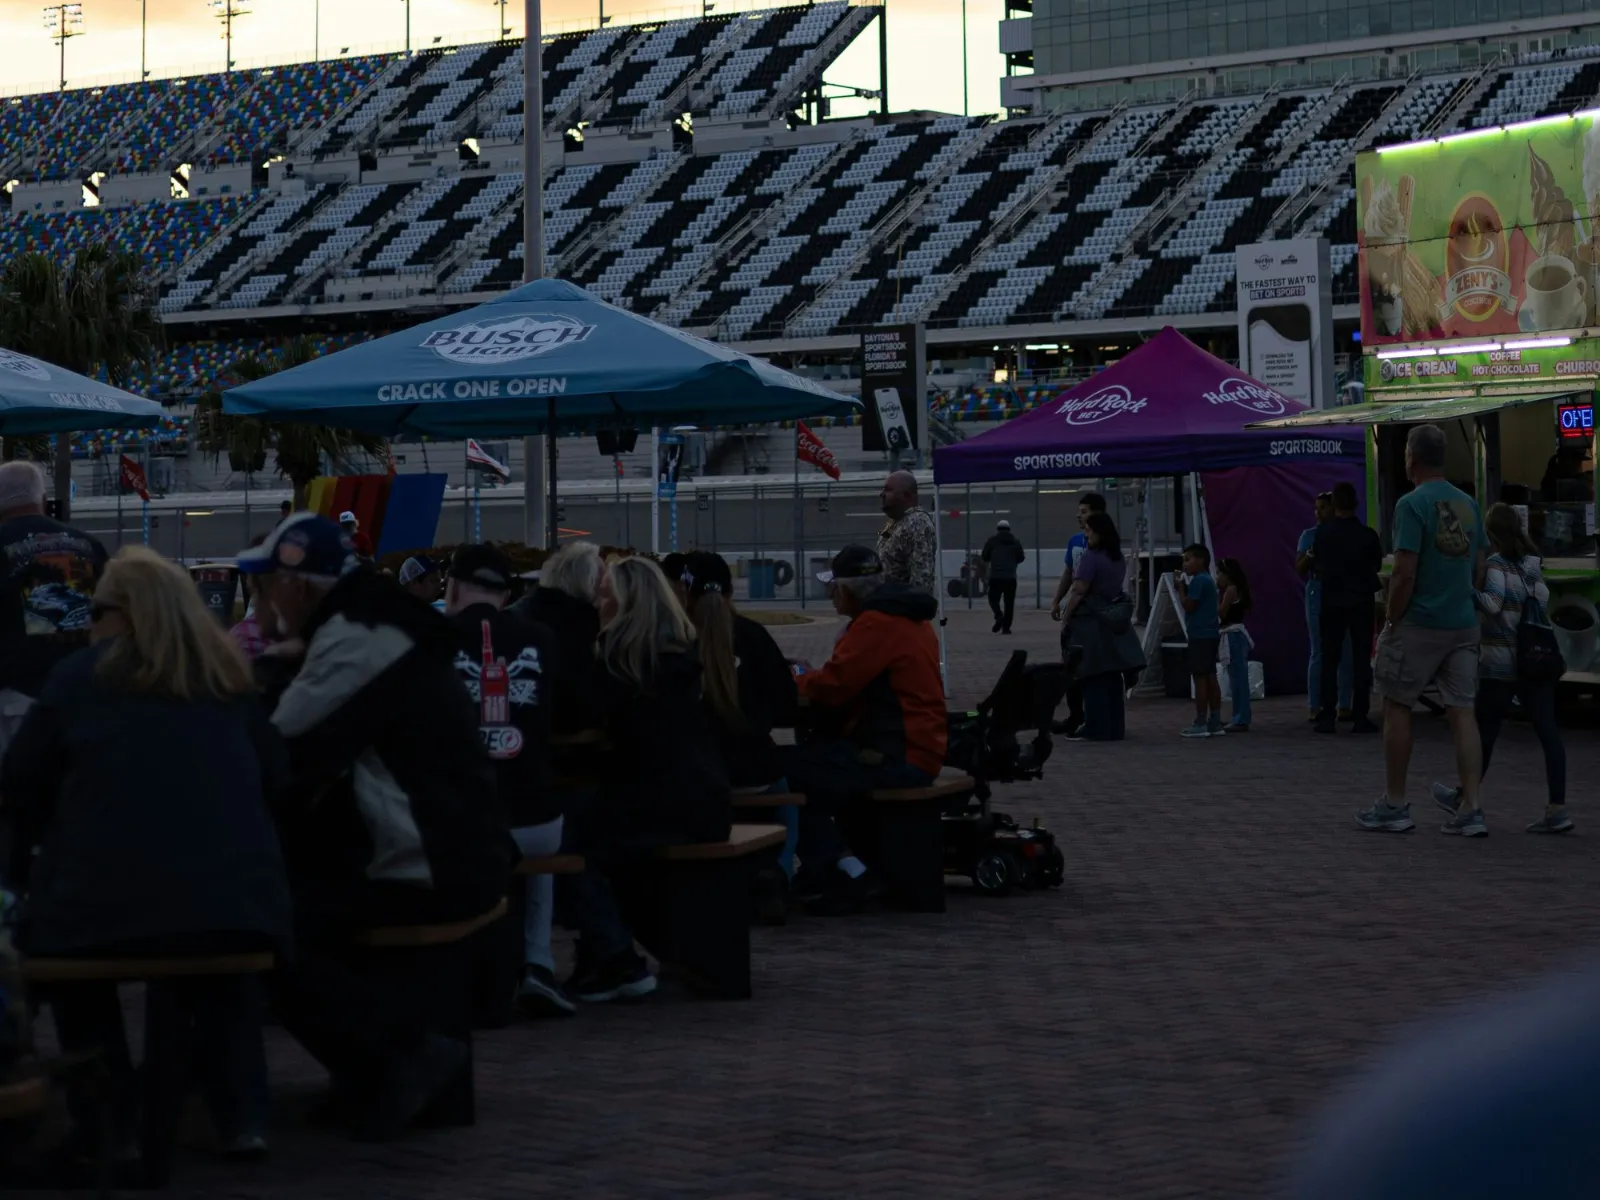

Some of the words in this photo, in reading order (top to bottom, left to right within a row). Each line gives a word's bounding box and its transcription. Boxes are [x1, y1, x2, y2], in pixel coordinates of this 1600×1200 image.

[1240, 281, 1254, 289] THE
[1255, 278, 1286, 288] FASTEST
[1288, 276, 1304, 285] WAY
[1307, 275, 1316, 283] TO
[1456, 271, 1497, 294] ZENY'S
[1251, 290, 1264, 299] BET
[1265, 289, 1275, 298] ON
[1276, 287, 1304, 297] SPORTS
[424, 326, 593, 346] BUSCH
[864, 332, 900, 342] DAYTONA'S
[449, 345, 545, 355] LIGHT
[864, 342, 908, 352] SPORTSBOOK
[864, 351, 897, 361] FLORIDA'S
[1490, 351, 1520, 362] COFFEE
[864, 360, 908, 371] SPORTSBOOK
[1393, 362, 1412, 377] ICE
[1415, 360, 1457, 376] CREAM
[1472, 366, 1490, 375] HOT
[1490, 364, 1540, 375] CHOCOLATE
[377, 382, 447, 401] CRACK
[453, 380, 500, 399] ONE
[506, 377, 567, 396] OPEN
[1202, 386, 1250, 404] Hard
[1054, 394, 1108, 414] Hard
[1098, 394, 1148, 413] Rock
[1252, 401, 1274, 409] BET
[1076, 411, 1102, 420] BET
[1562, 409, 1593, 428] OPE
[1269, 439, 1343, 456] SPORTSBOOK
[1013, 452, 1101, 471] SPORTSBOOK
